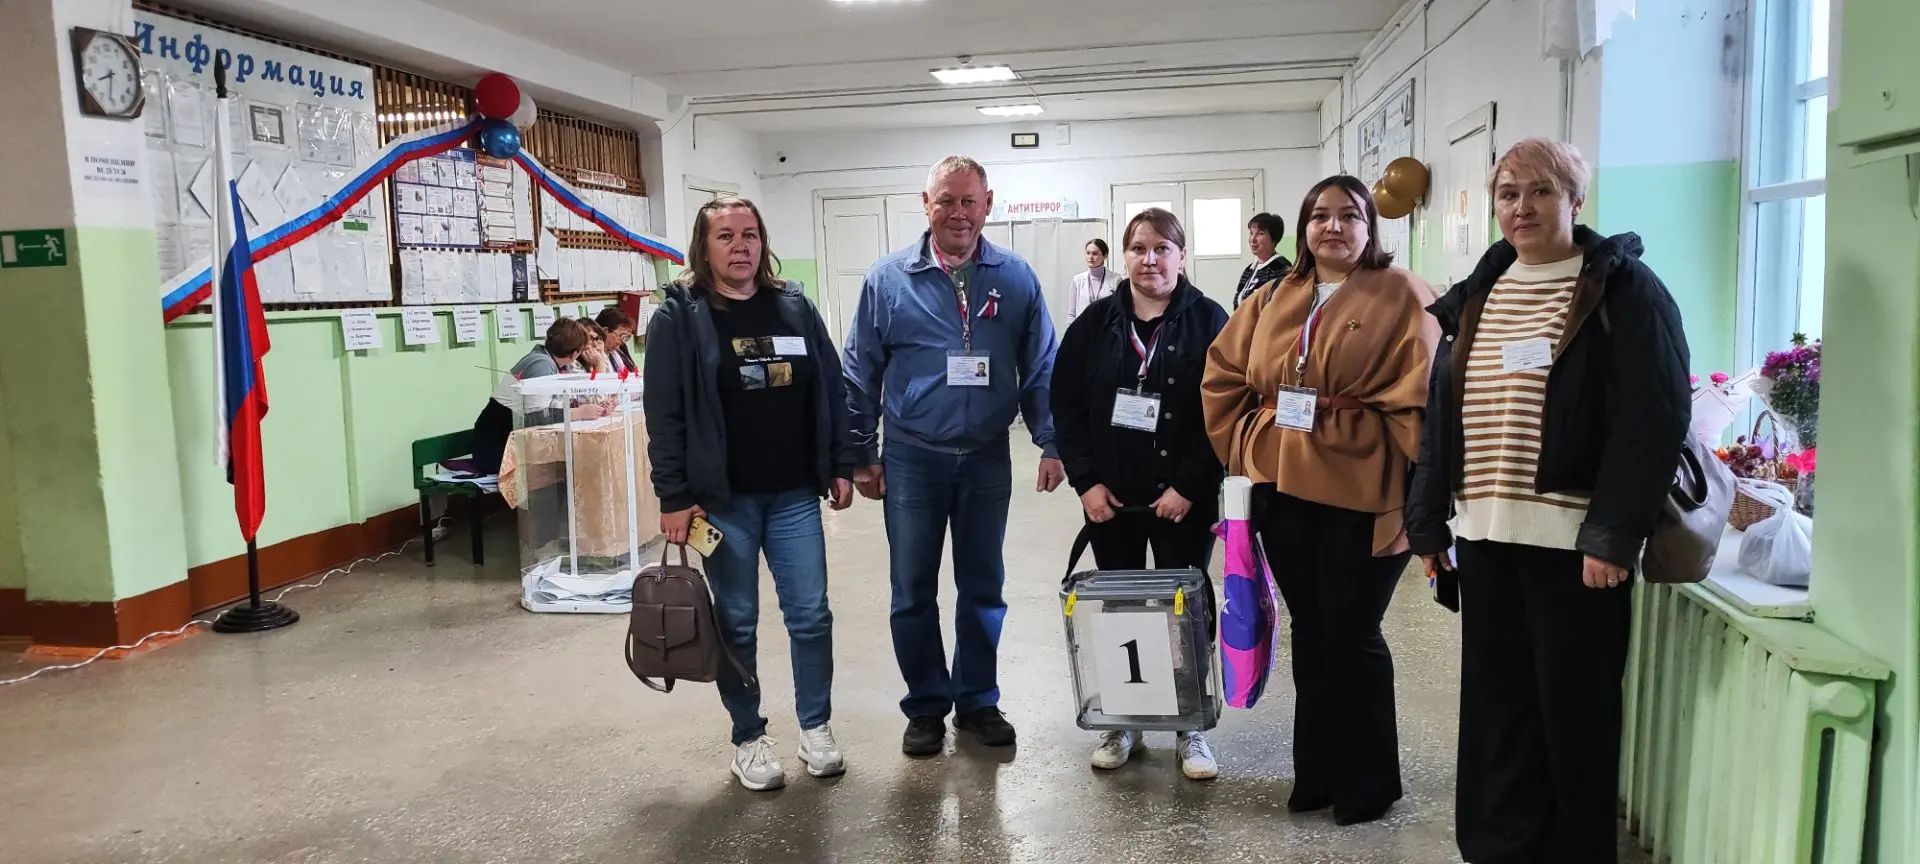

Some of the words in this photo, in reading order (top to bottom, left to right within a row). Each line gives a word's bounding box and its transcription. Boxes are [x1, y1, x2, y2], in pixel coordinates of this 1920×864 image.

[134, 20, 364, 101] Информация
[1008, 202, 1061, 214] АНТИТЕРРОР
[1119, 638, 1149, 683] 1
